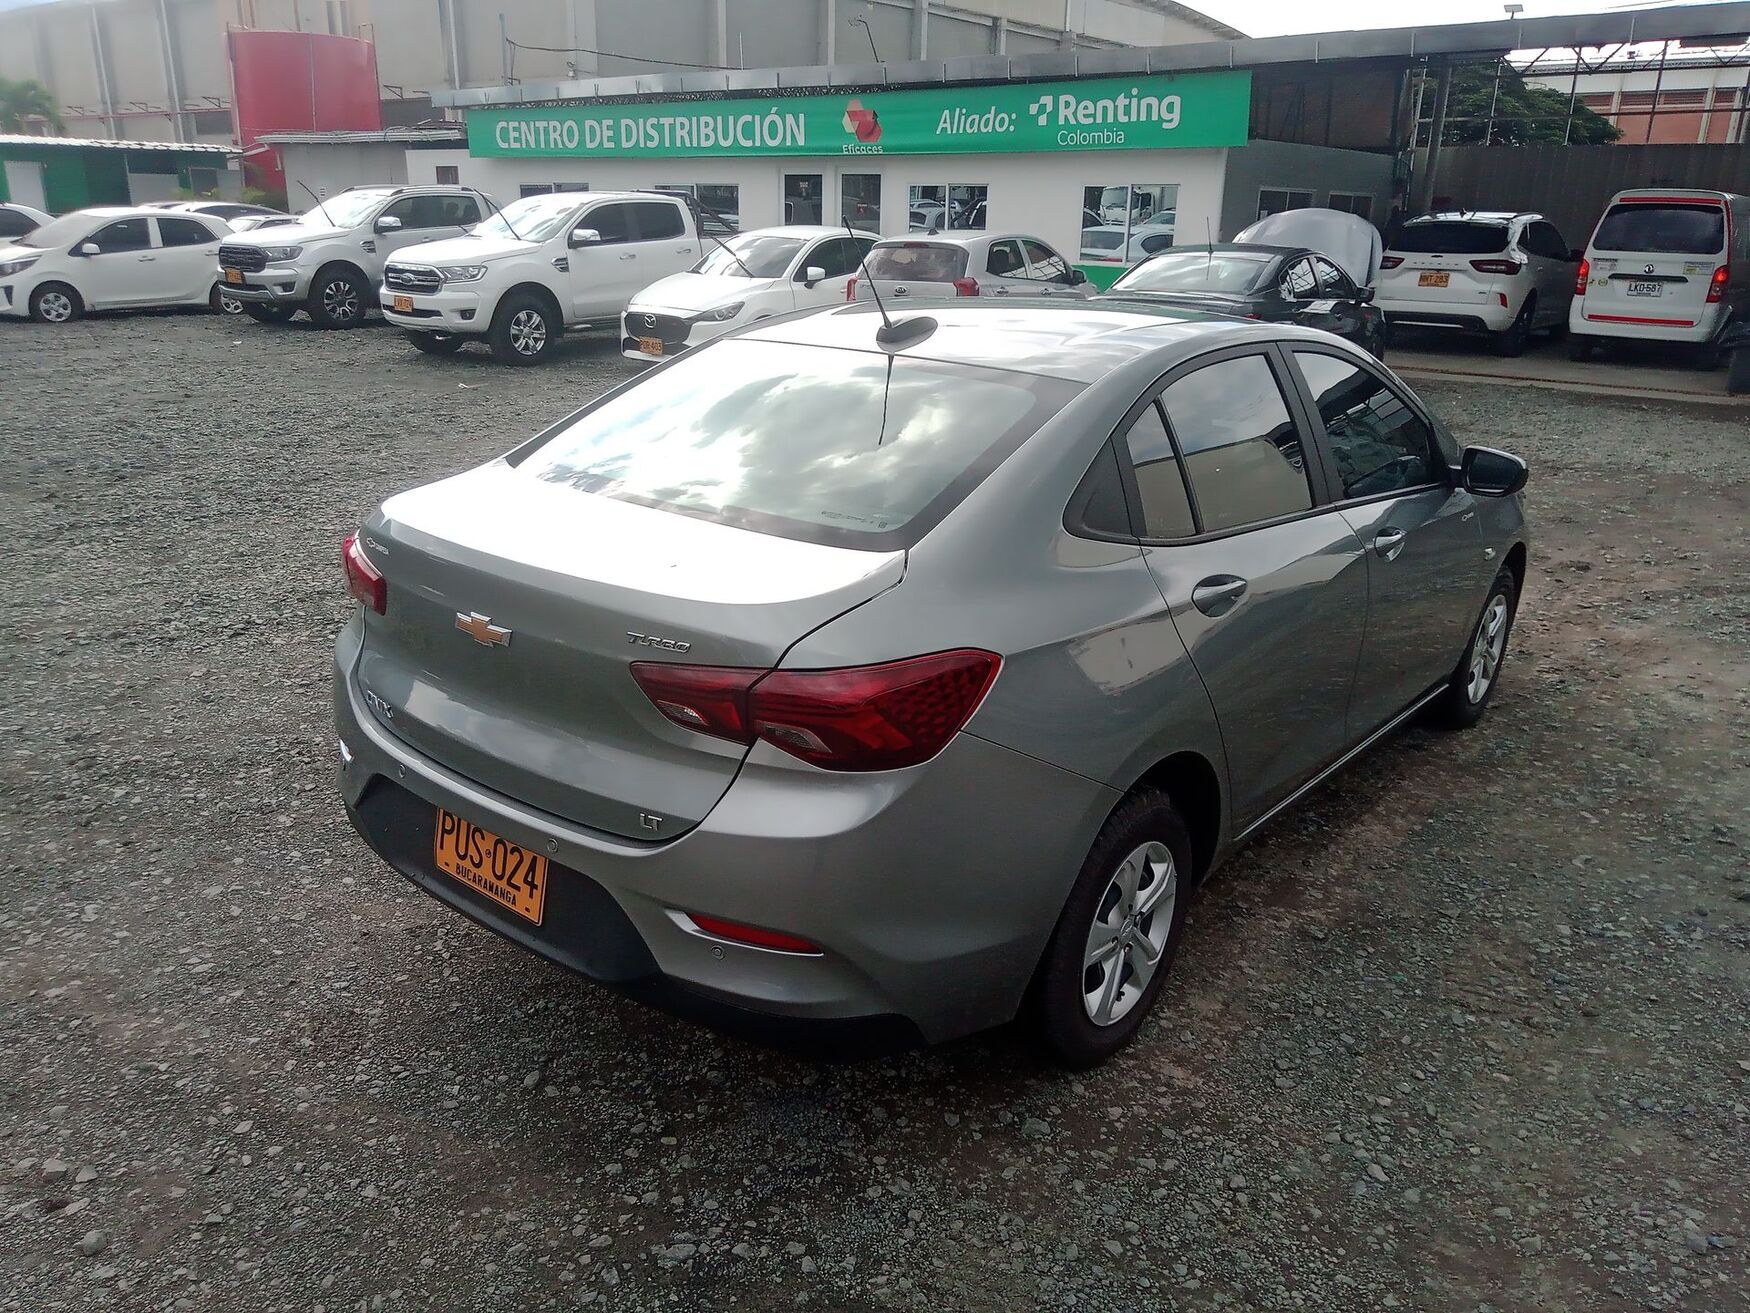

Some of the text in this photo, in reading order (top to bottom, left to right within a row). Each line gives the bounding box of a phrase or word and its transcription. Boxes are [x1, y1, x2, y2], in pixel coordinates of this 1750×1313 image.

[936, 106, 1017, 135] Aliado:
[1058, 87, 1182, 130] Renting
[495, 107, 805, 149] CENTRO DE DISTRIBUCIÓN
[1057, 129, 1125, 146] Colombia
[842, 144, 883, 154] Eficaces
[627, 631, 692, 653] TURBO
[640, 813, 663, 831] LT
[455, 862, 517, 907] BUCARAMANGA
